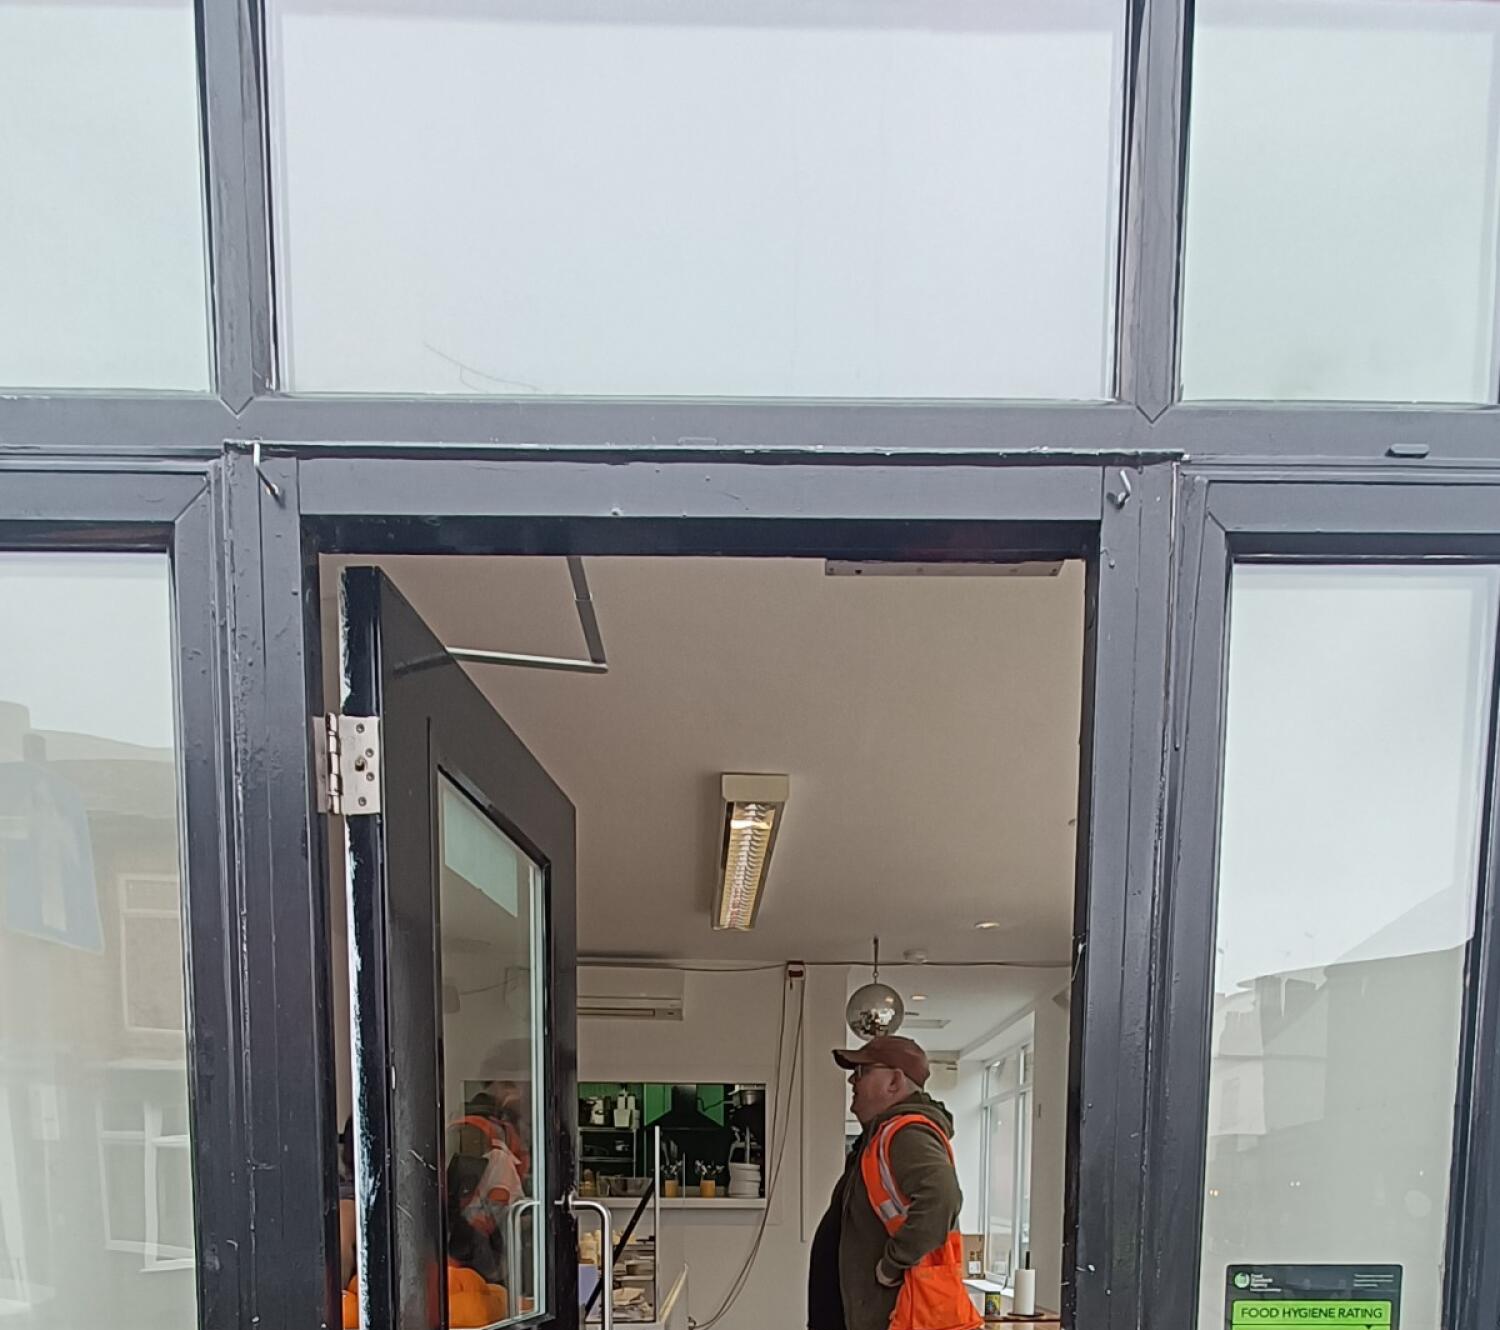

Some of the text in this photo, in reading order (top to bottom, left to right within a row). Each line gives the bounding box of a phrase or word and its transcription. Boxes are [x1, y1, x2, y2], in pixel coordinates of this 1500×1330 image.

[1240, 1307, 1383, 1319] FOOD HYGIENE RATING
